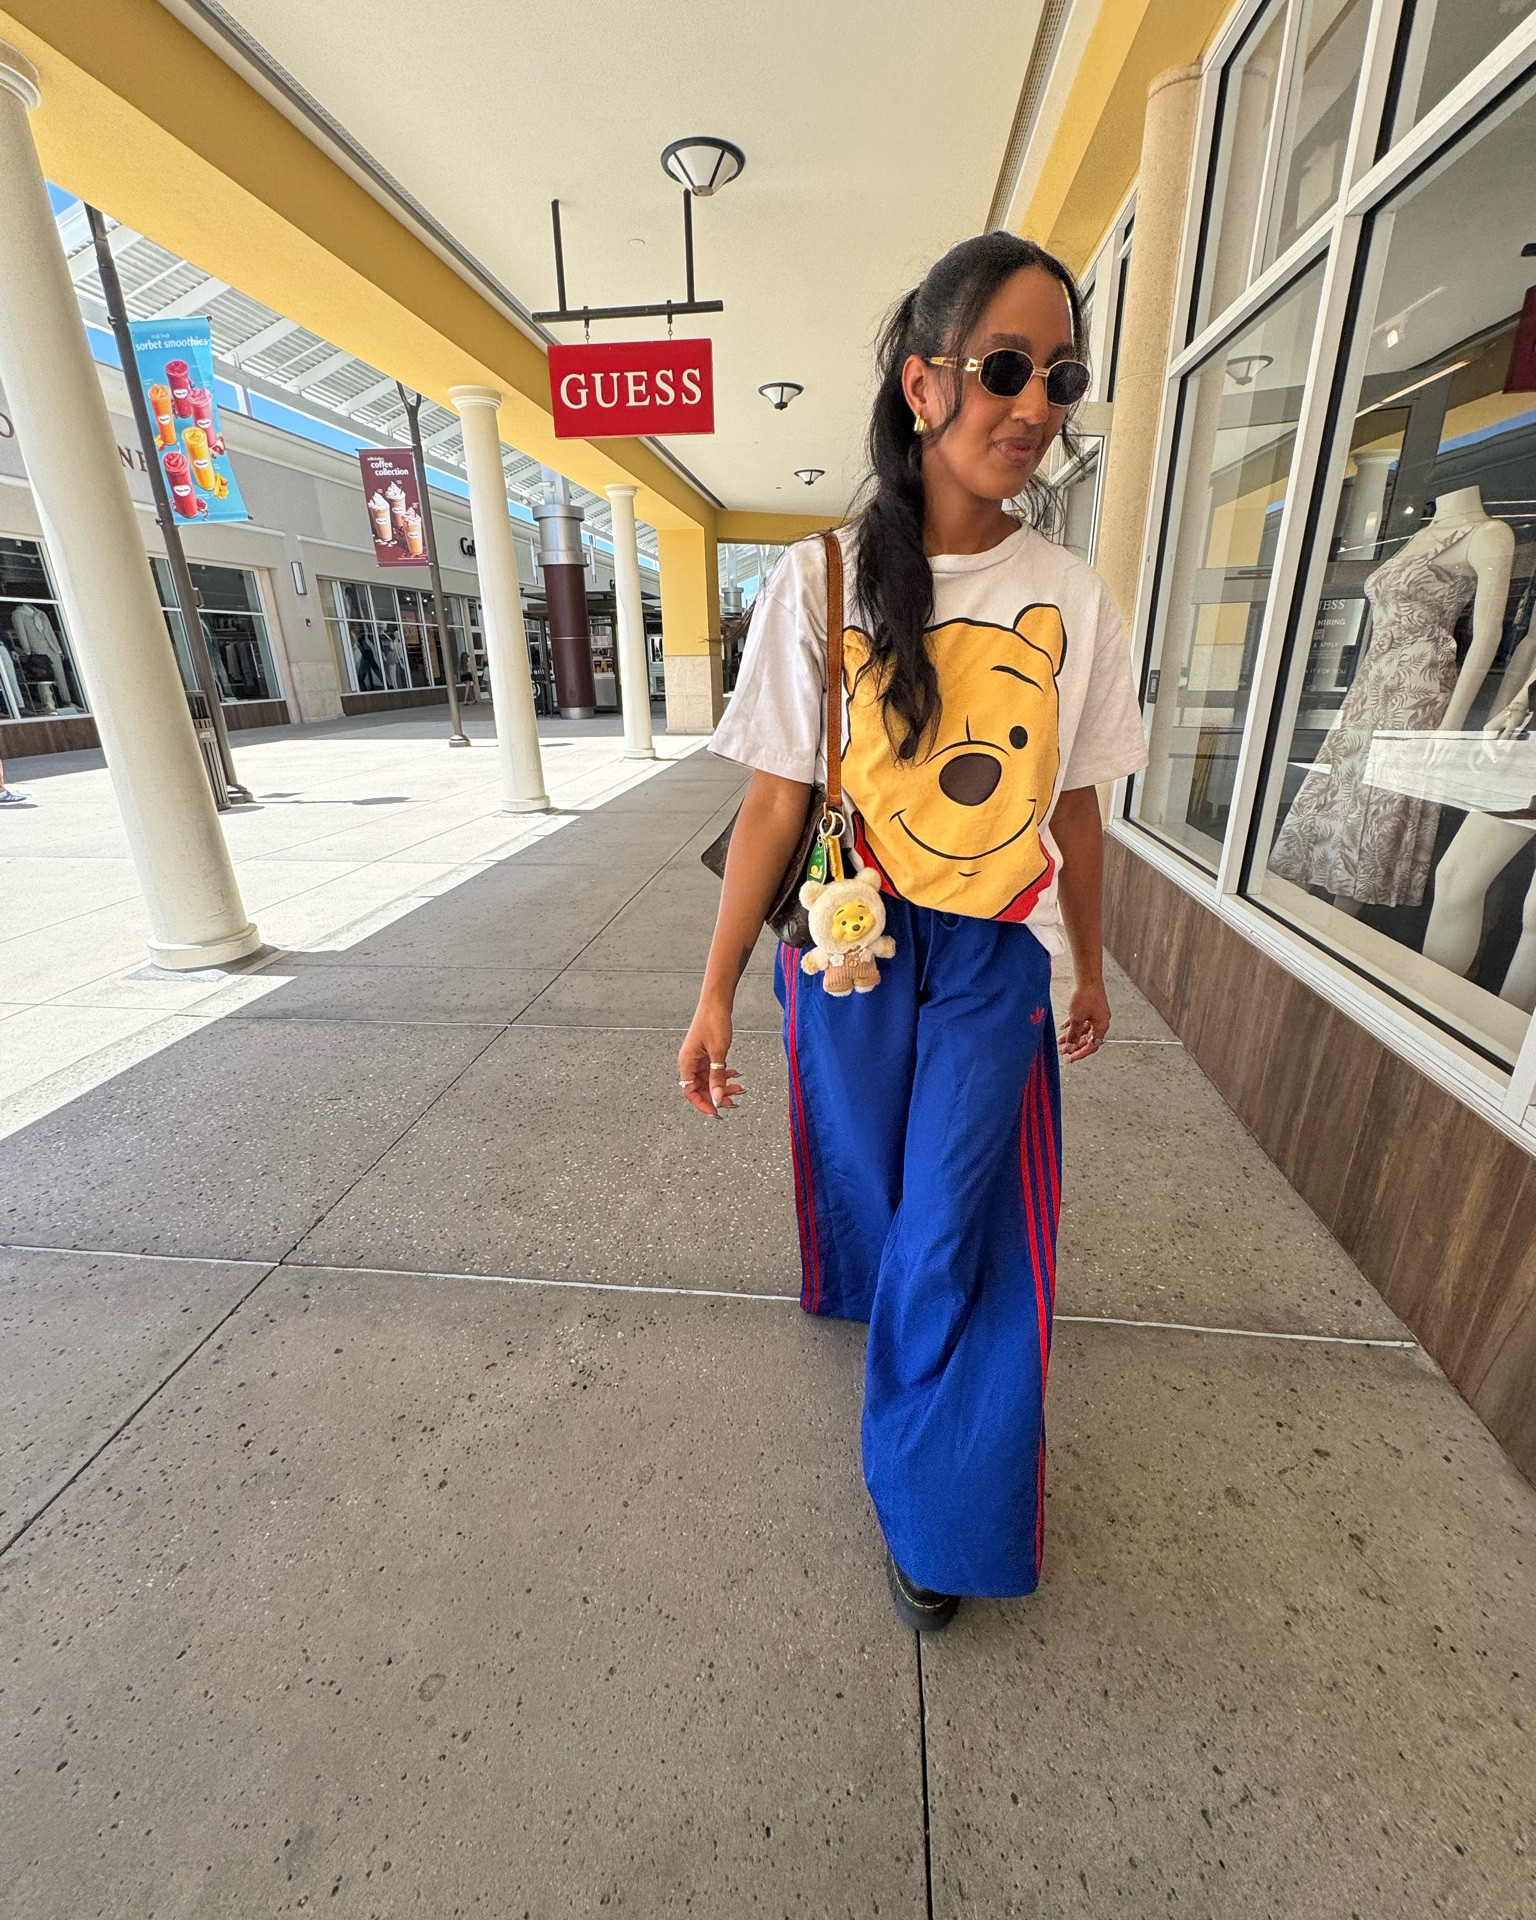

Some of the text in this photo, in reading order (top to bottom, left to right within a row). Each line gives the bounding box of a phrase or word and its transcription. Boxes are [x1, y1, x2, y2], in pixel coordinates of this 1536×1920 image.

[136, 335, 209, 351] sorbet smoothies
[560, 368, 702, 410] GUESS
[371, 461, 393, 469] coffee
[375, 467, 409, 476] collection
